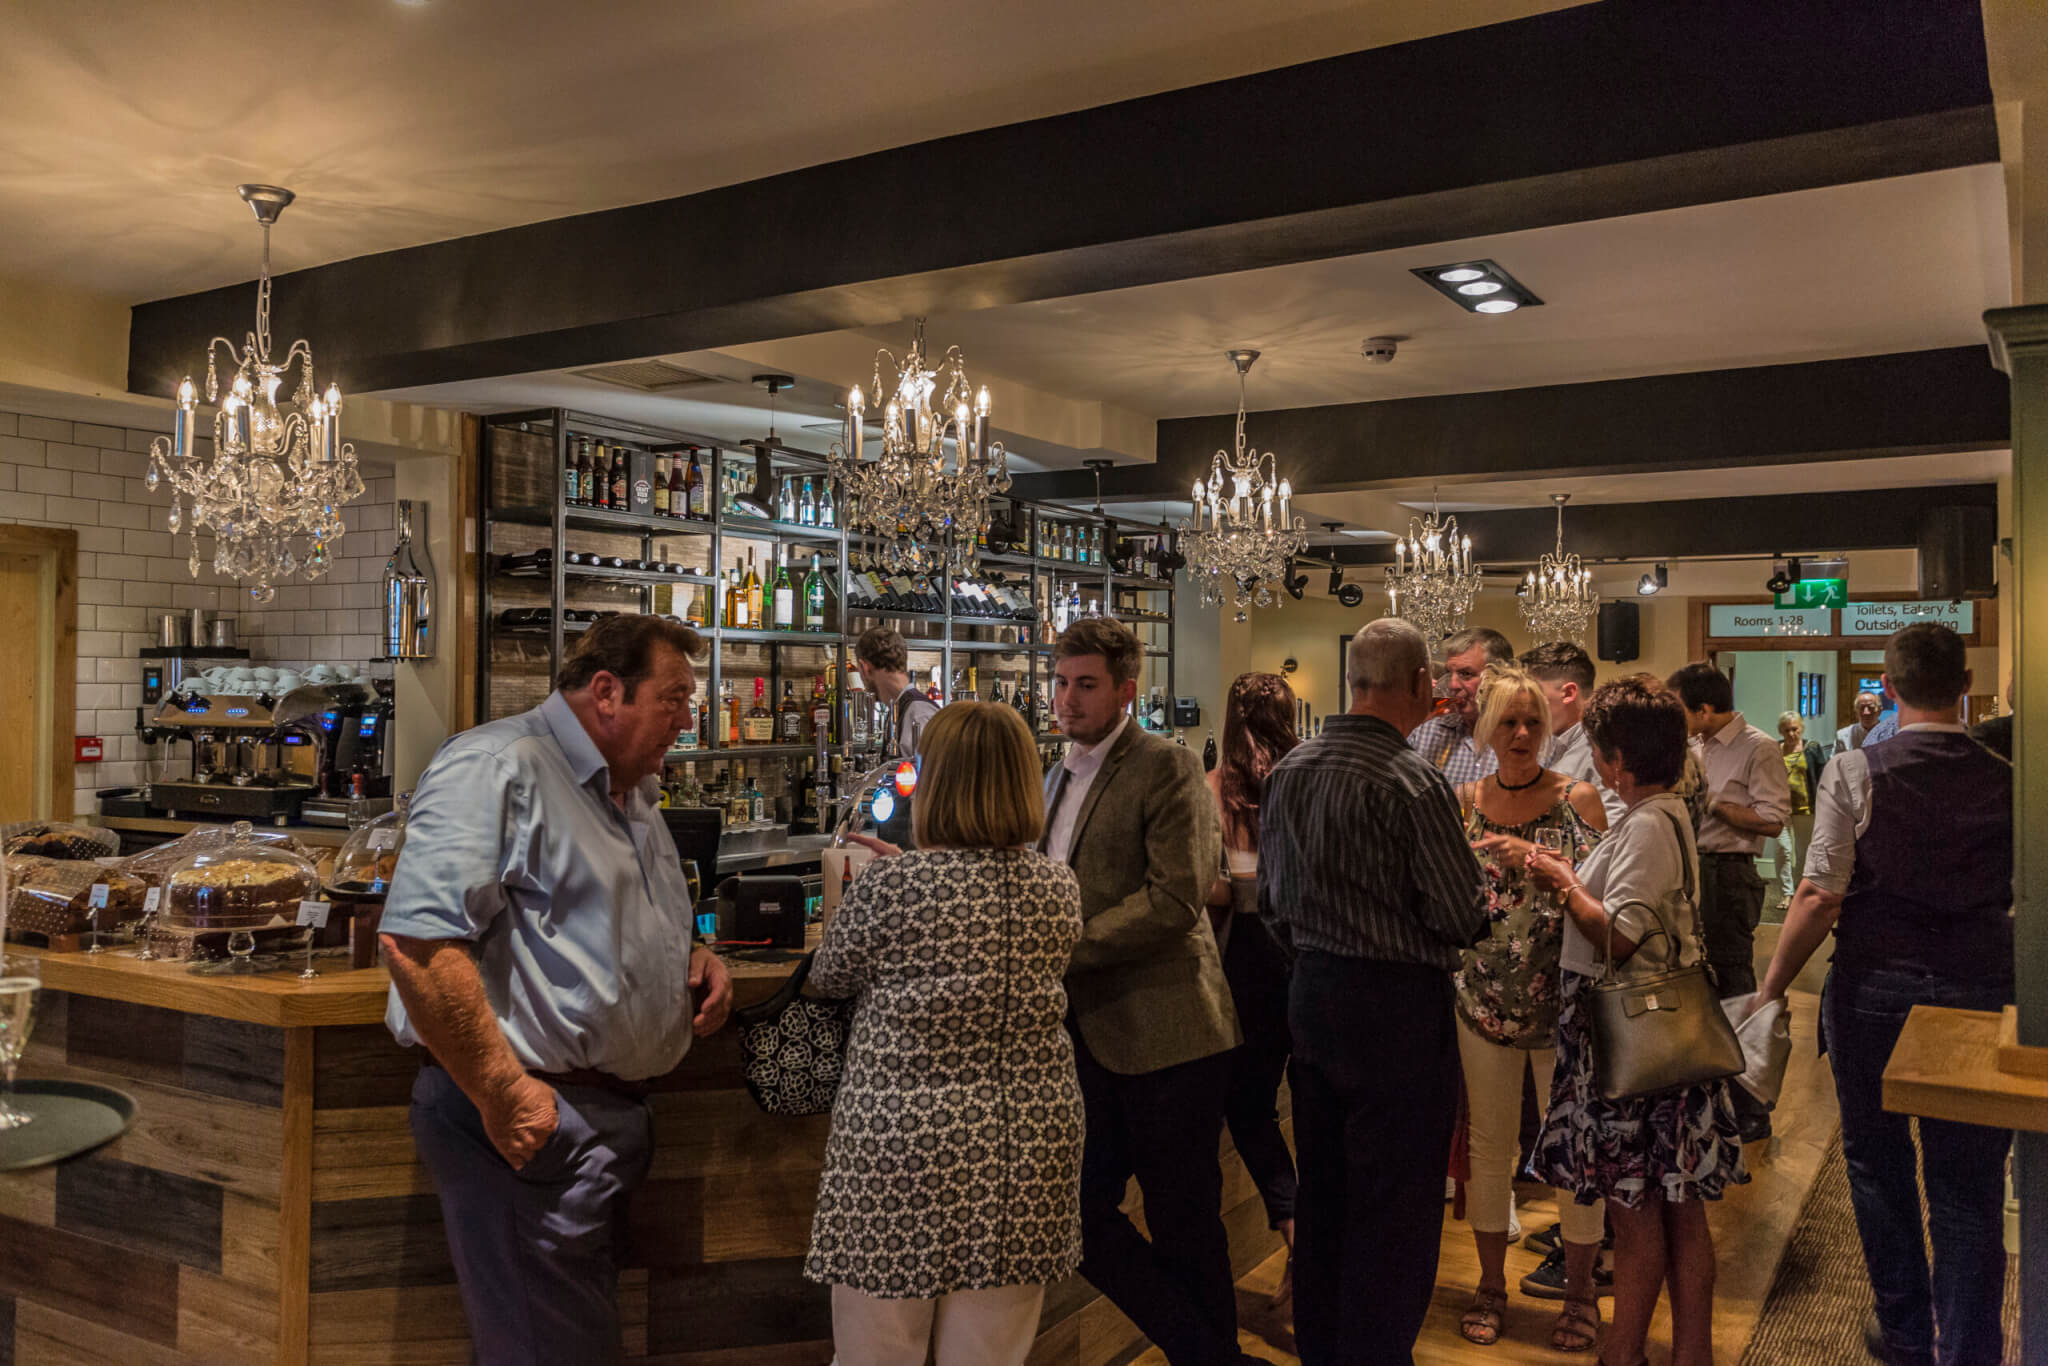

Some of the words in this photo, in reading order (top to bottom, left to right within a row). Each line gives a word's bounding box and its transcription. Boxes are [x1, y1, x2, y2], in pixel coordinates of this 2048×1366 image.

[1856, 604, 1898, 616] Toilets,
[1902, 603, 1944, 616] Eatery
[1948, 603, 1959, 614] &
[1734, 615, 1774, 626] Rooms
[1778, 615, 1804, 626] 1-28
[1855, 619, 1905, 631] Outside
